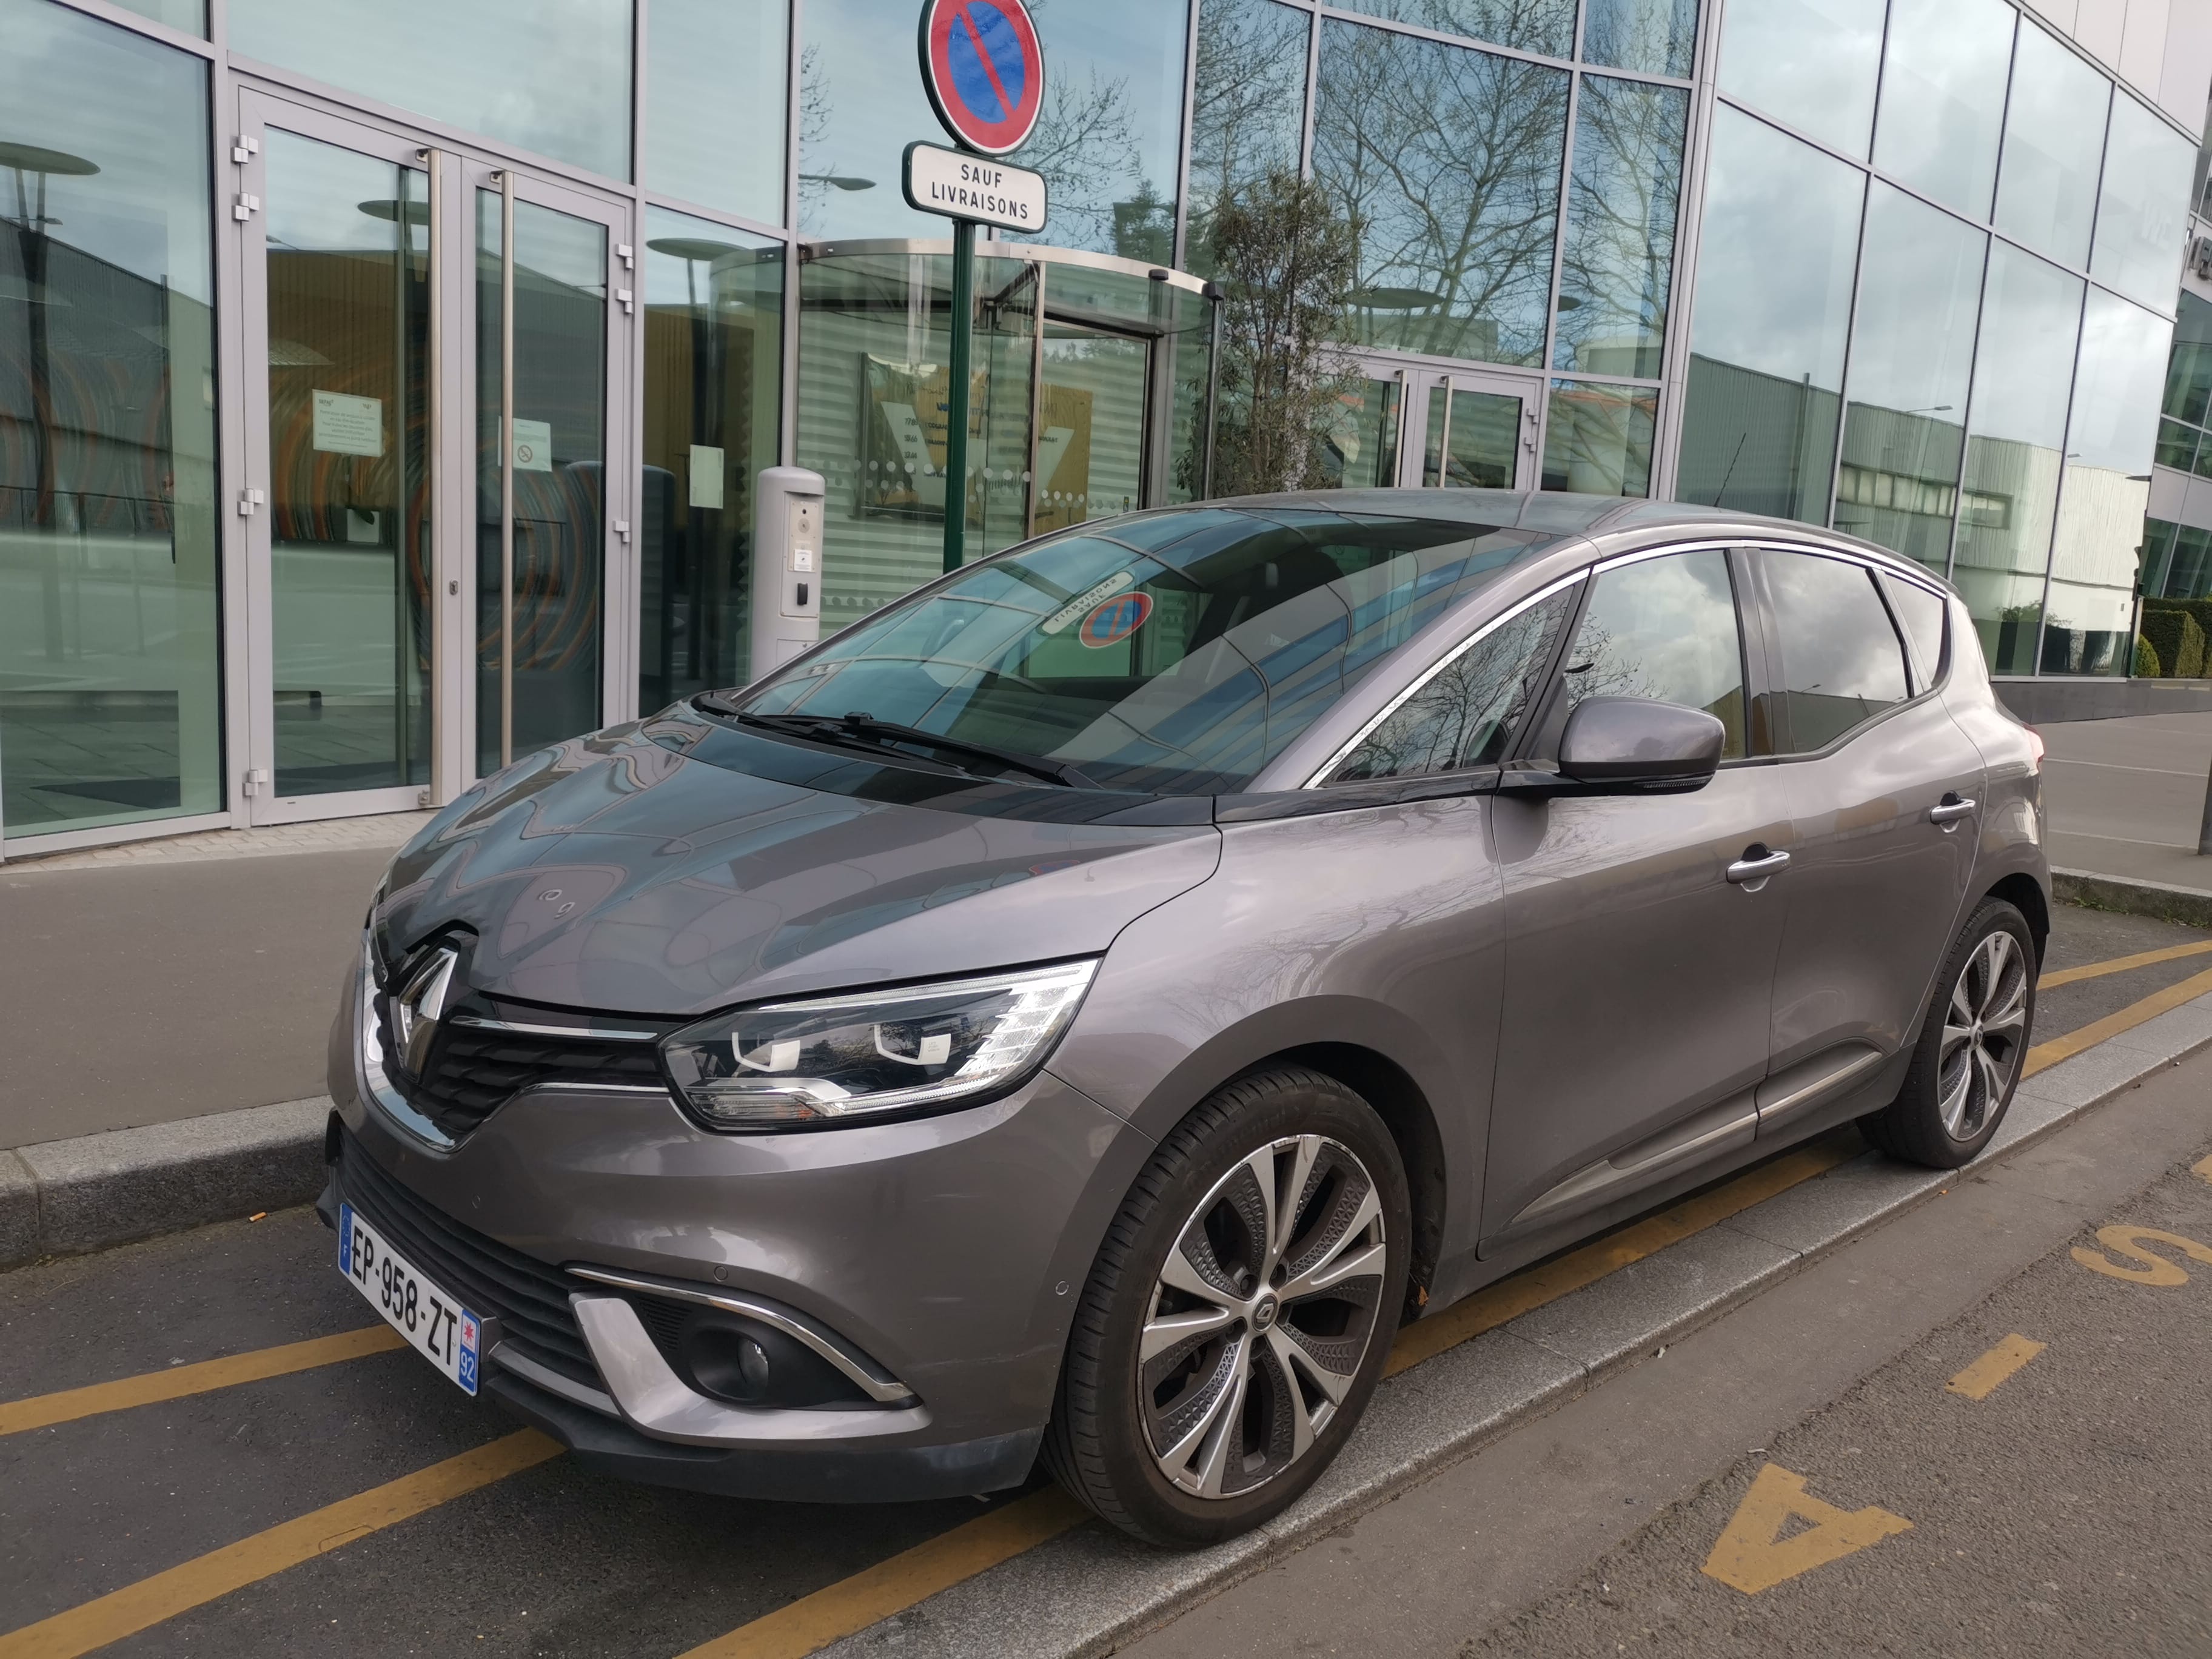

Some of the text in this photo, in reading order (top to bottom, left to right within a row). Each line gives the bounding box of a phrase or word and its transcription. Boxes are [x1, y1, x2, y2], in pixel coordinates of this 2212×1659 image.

[961, 164, 1002, 188] SAUF
[932, 181, 1028, 219] LIVRAISONS
[352, 1225, 457, 1366] EP-958-ZT
[461, 1351, 474, 1383] 92
